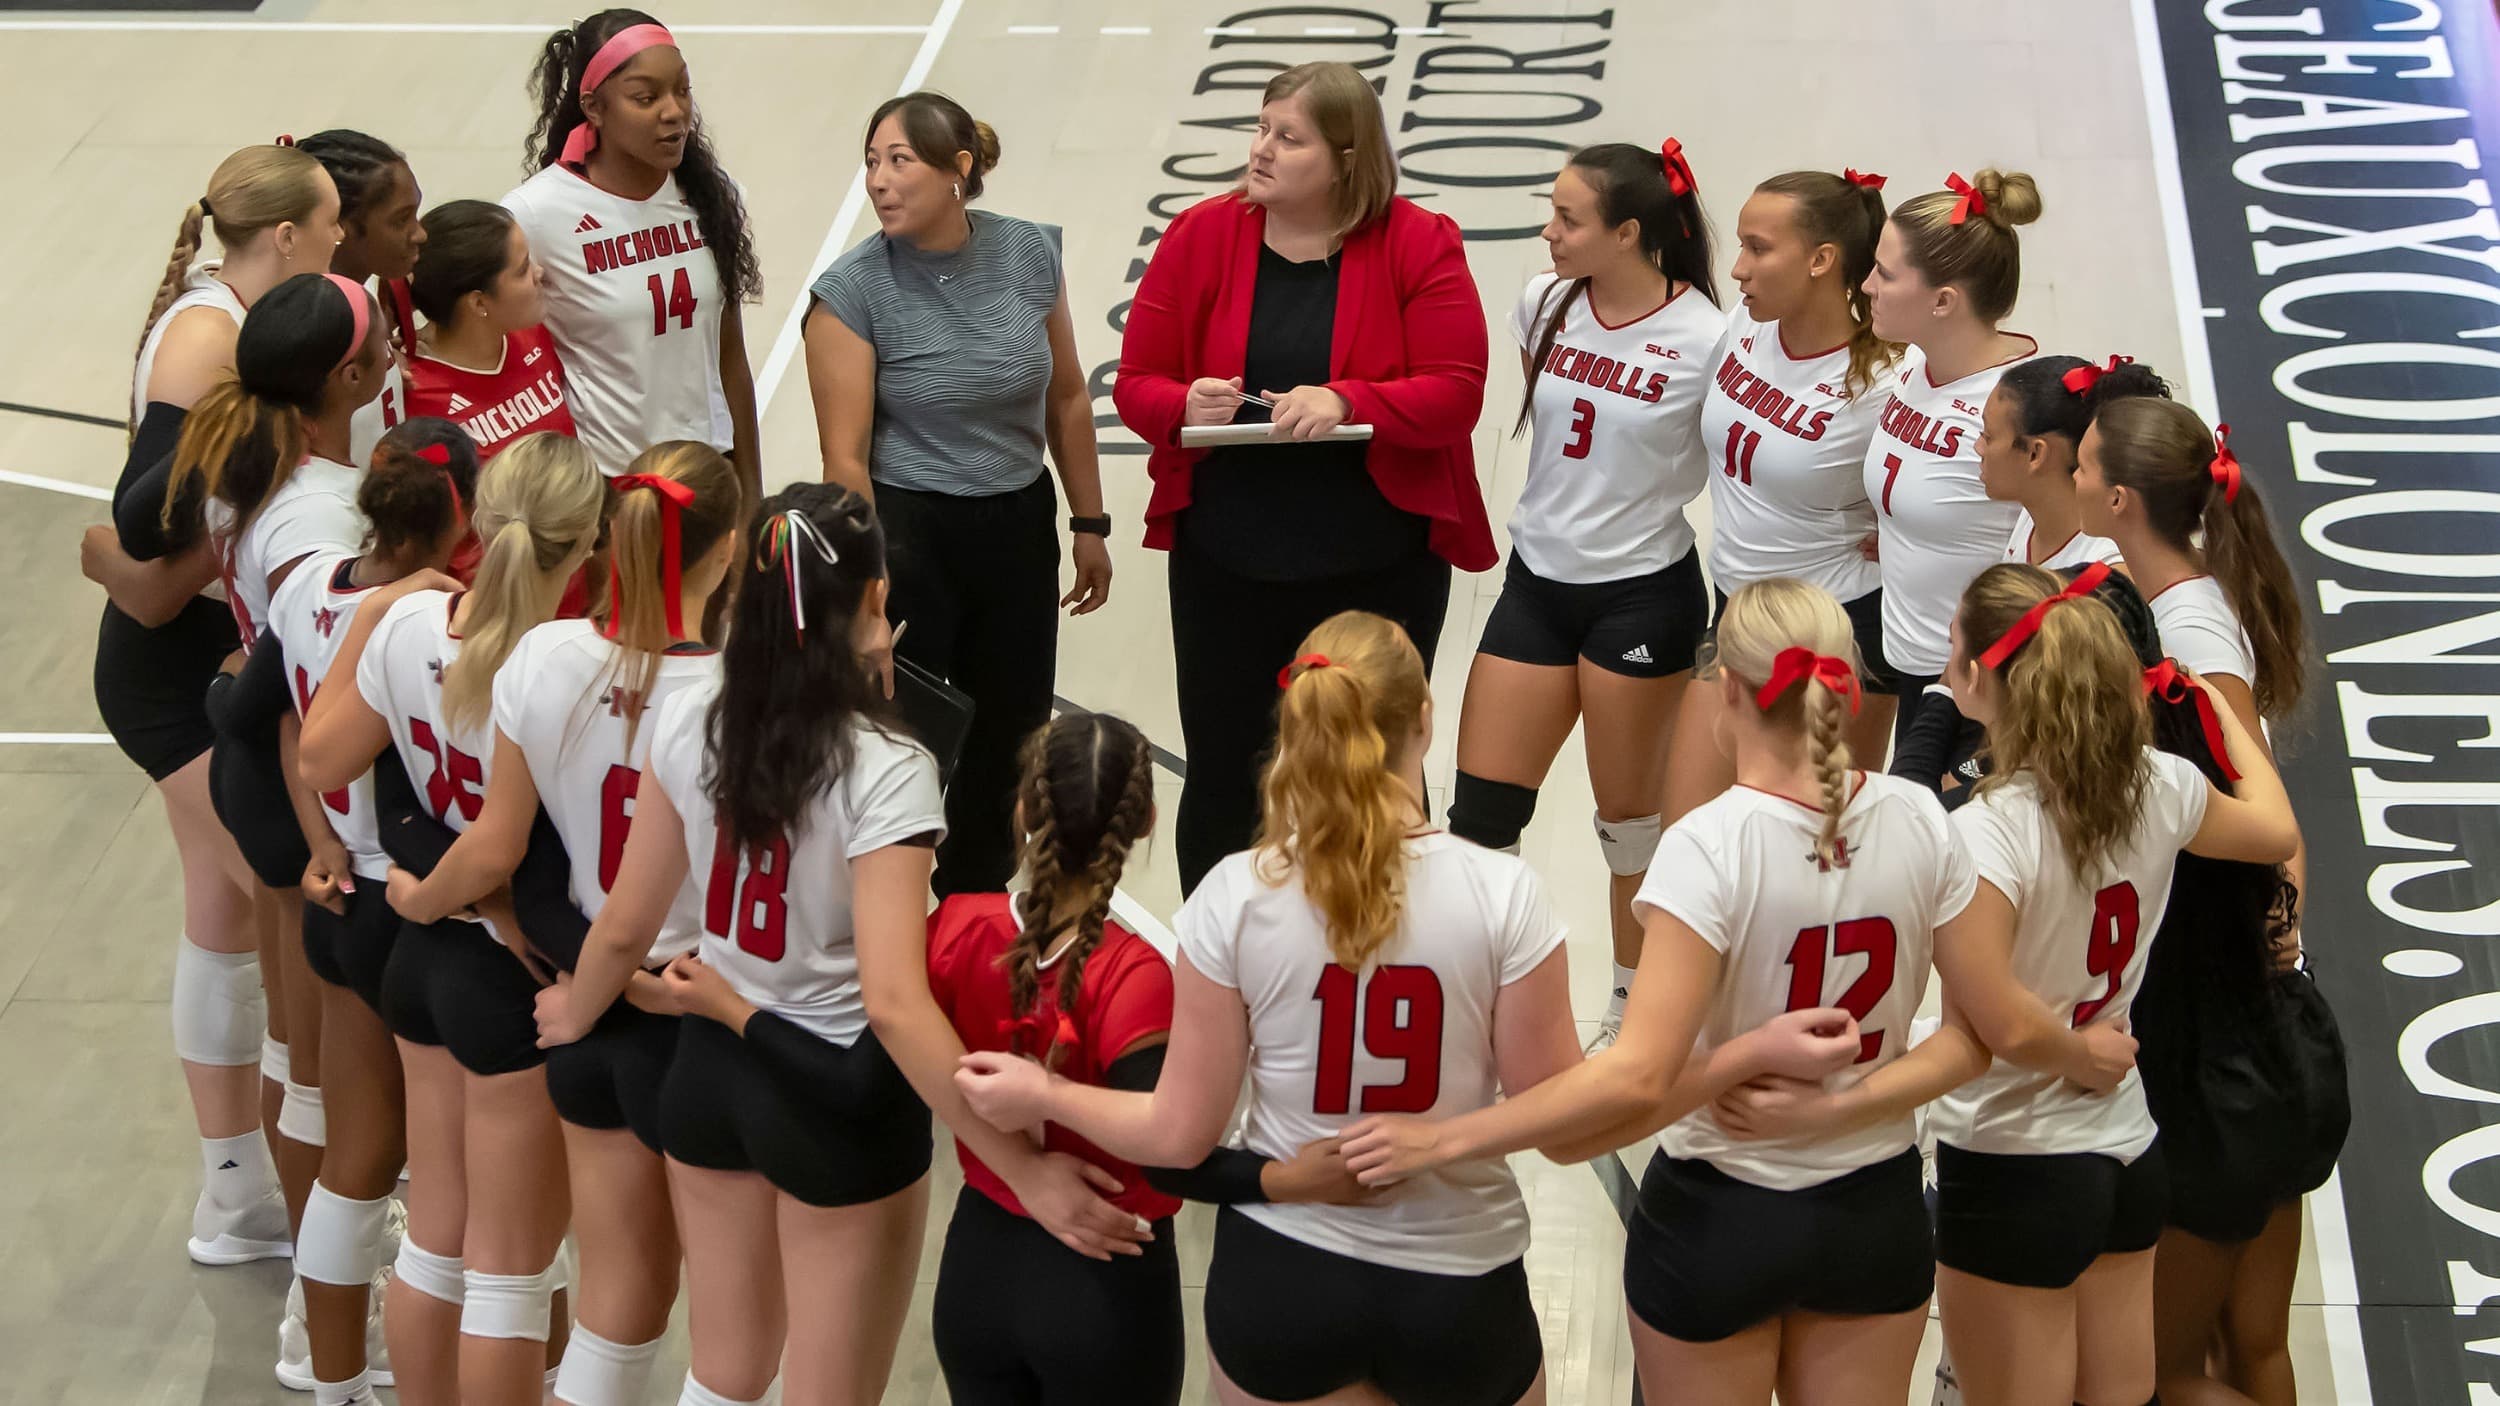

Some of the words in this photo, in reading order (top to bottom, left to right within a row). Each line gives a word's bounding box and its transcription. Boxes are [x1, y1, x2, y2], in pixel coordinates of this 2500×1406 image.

[582, 219, 706, 275] NICHOLL
[647, 267, 698, 336] 14
[1544, 343, 1669, 403] ICHOLLS
[1716, 351, 1835, 441] NICHOLLS
[1562, 397, 1596, 460] 3
[1724, 420, 1762, 487] 11
[1880, 393, 1965, 458] ICHOLLS
[2204, 0, 2500, 1406] GEAUXCOLONEL.
[705, 797, 790, 963] 18
[1785, 916, 1897, 1065] 12
[2071, 880, 2140, 1030] 9
[1312, 962, 1444, 1114] 19
